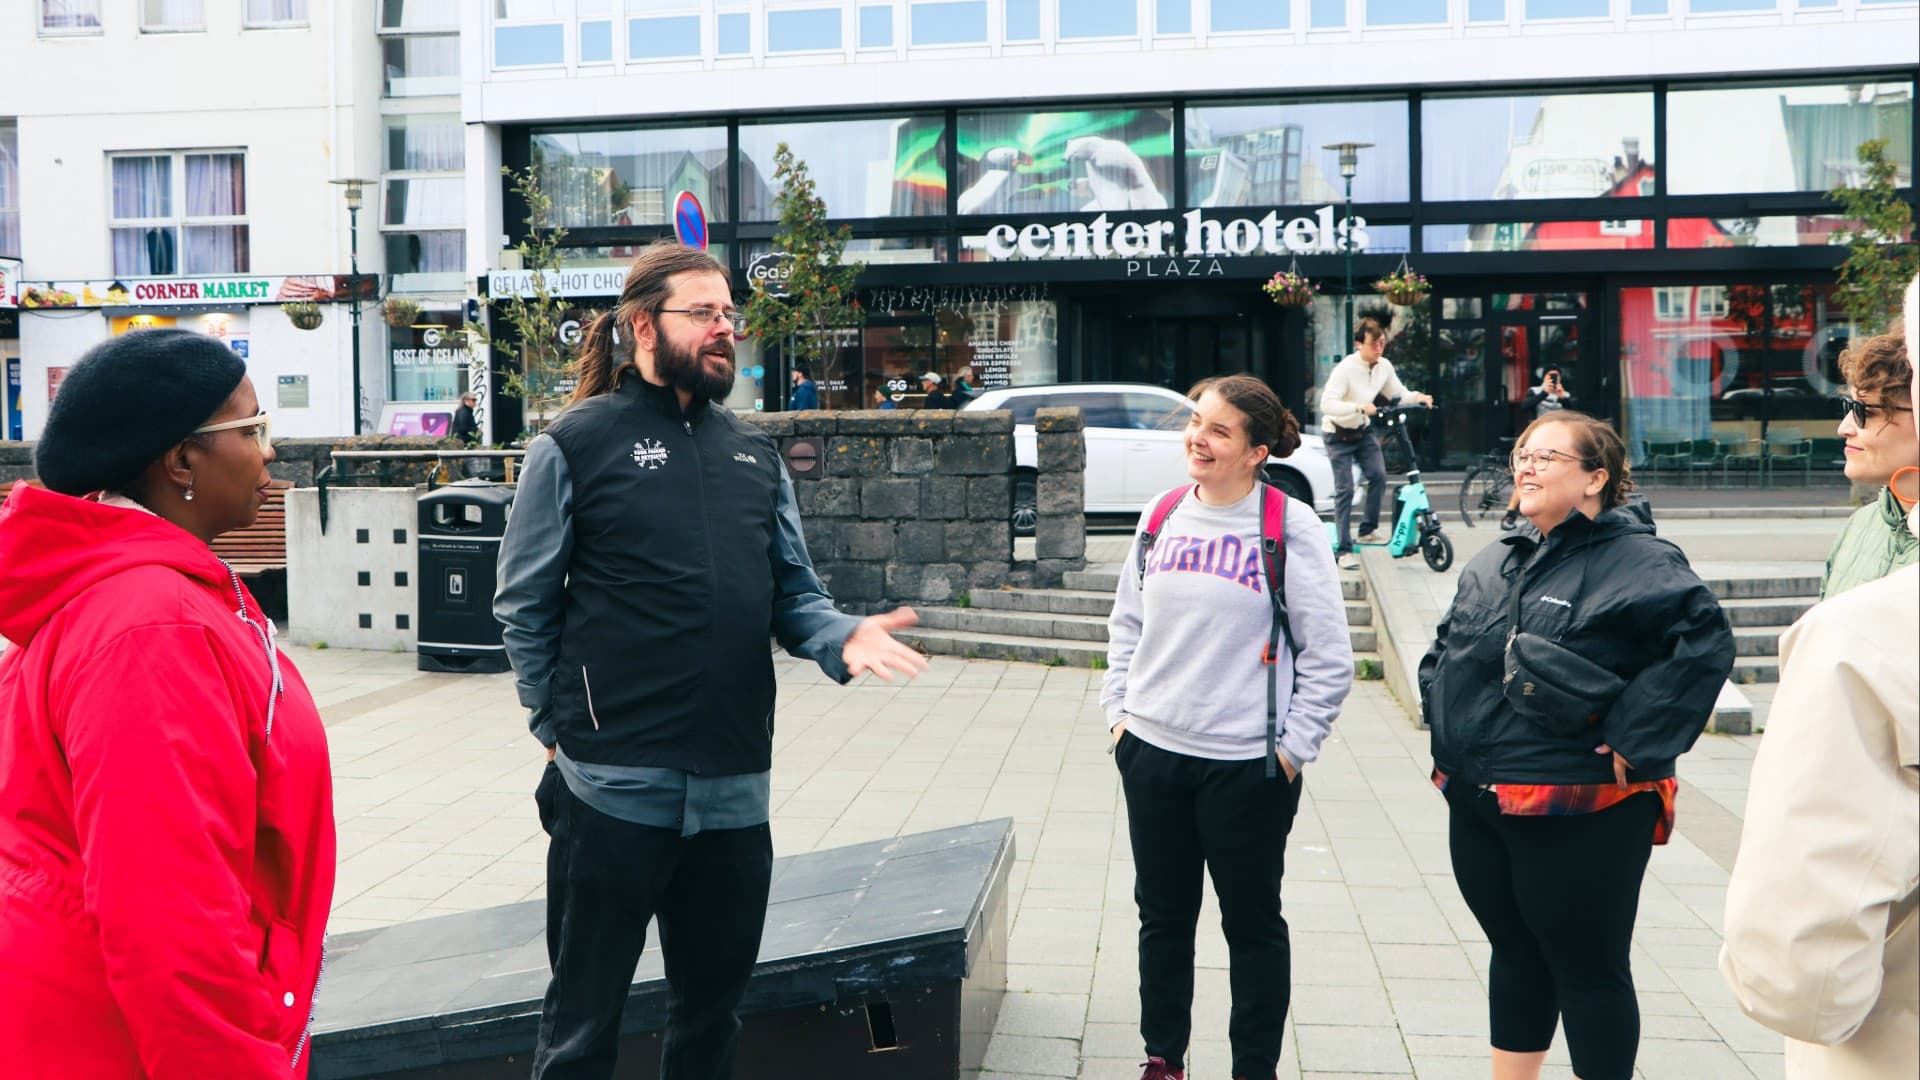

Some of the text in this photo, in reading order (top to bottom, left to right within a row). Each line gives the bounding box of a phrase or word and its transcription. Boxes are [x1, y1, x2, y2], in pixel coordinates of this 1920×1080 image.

[985, 205, 1370, 259] center hotels
[1127, 259, 1225, 277] PLAZA
[561, 273, 589, 290] HOT
[593, 272, 624, 289] CHO
[135, 281, 270, 300] CORNER MARKET
[393, 349, 417, 365] BEST
[418, 349, 429, 365] OF
[1146, 534, 1262, 594] LORIDA
